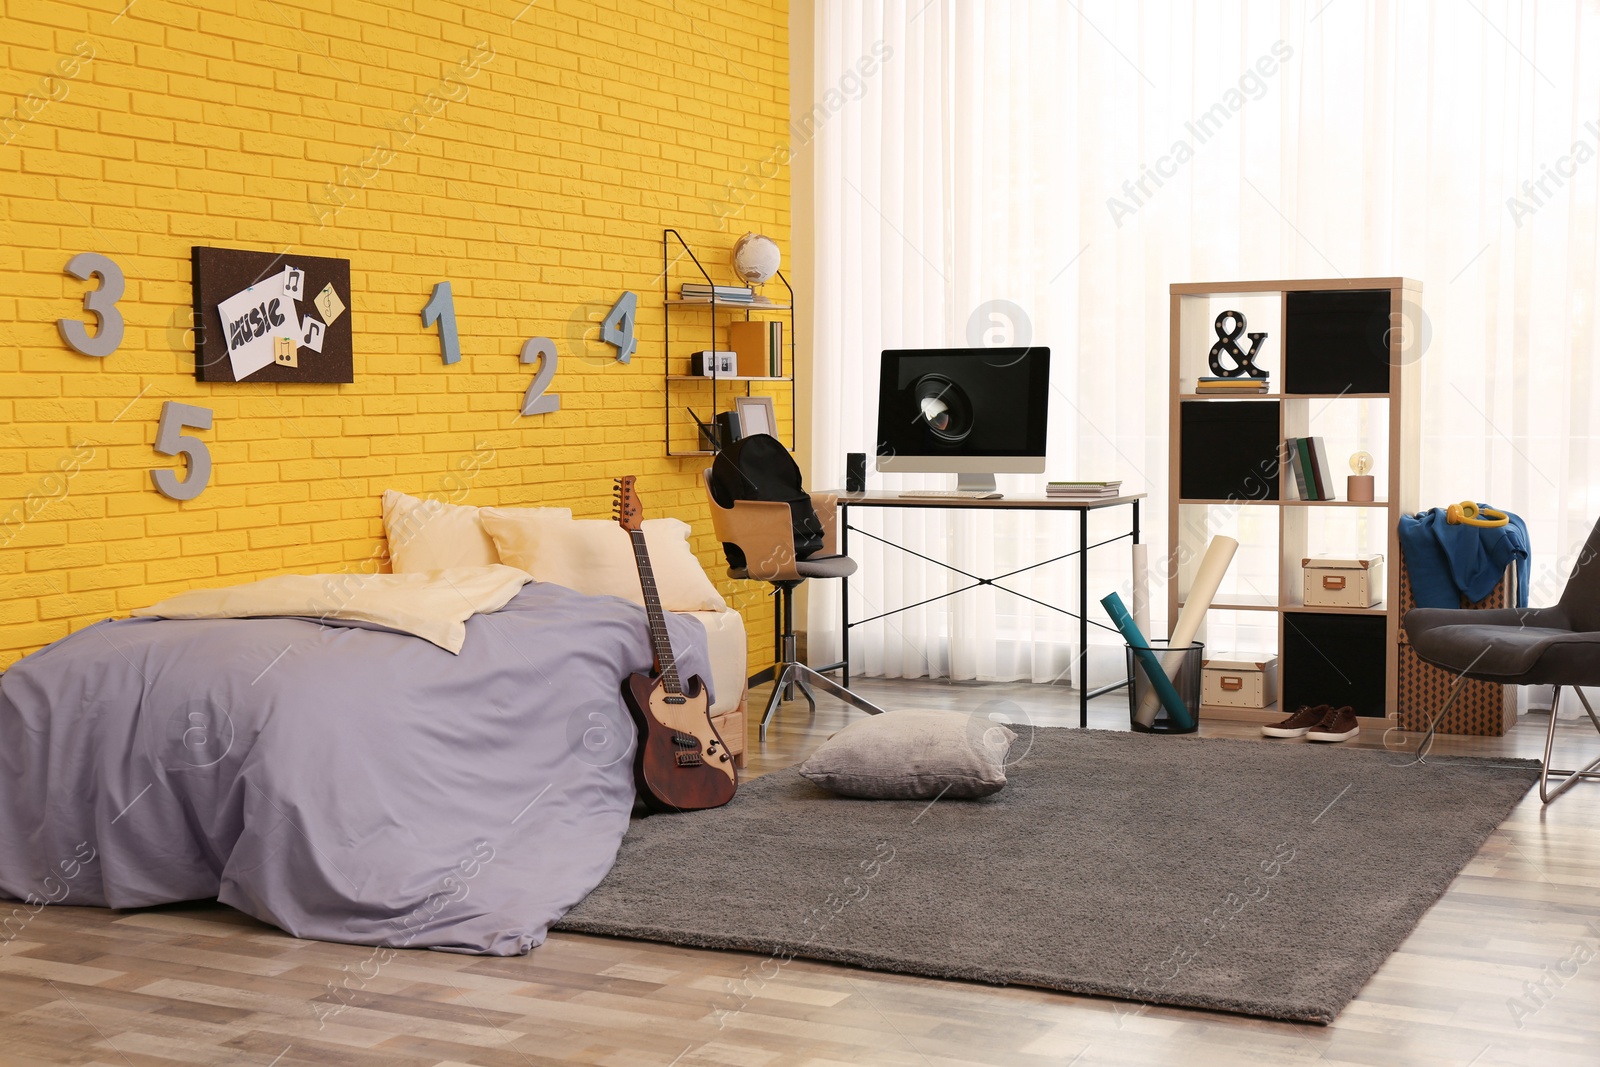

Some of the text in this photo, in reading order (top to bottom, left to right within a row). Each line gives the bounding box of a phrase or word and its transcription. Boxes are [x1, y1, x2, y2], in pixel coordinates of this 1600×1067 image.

[57, 252, 125, 357] 3
[229, 298, 286, 351] MUSIC
[421, 281, 461, 365] 1
[600, 291, 637, 364] 4
[520, 336, 560, 416] 2
[150, 401, 213, 500] 5
